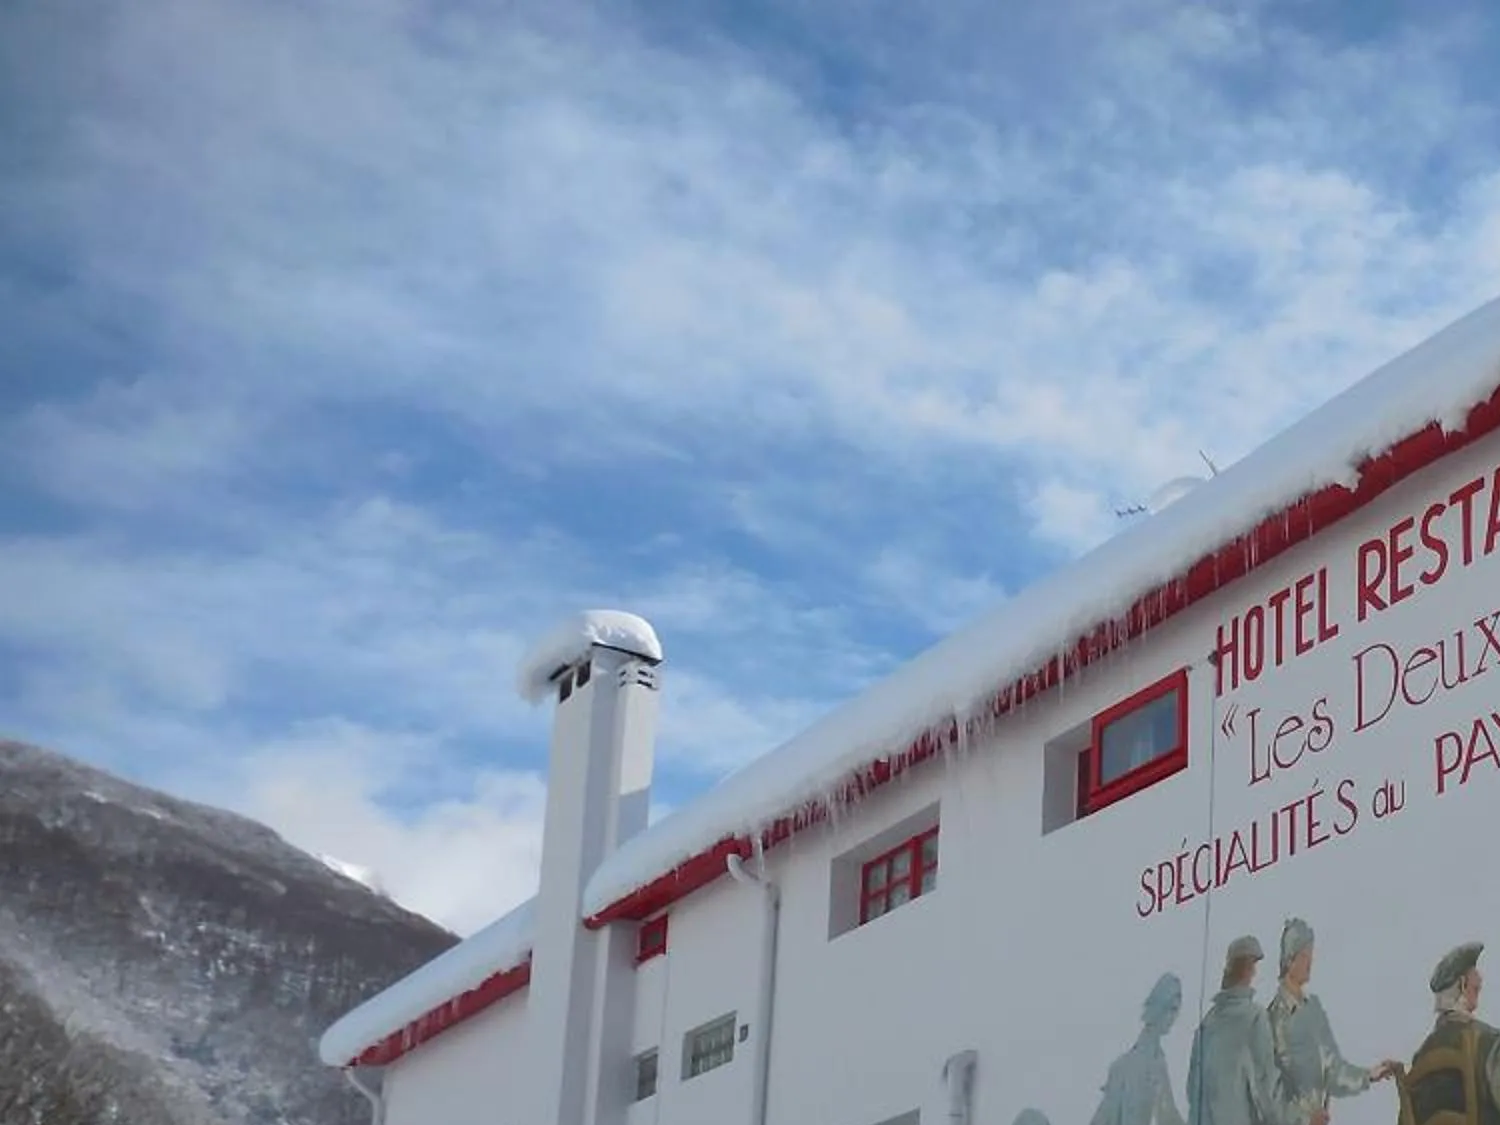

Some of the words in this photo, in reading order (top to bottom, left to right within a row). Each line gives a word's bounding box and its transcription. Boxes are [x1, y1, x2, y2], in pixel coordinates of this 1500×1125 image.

[1213, 567, 1339, 697] HOTEL
[1136, 778, 1359, 918] SPÉCIALITÉS
[1372, 778, 1406, 820] du
